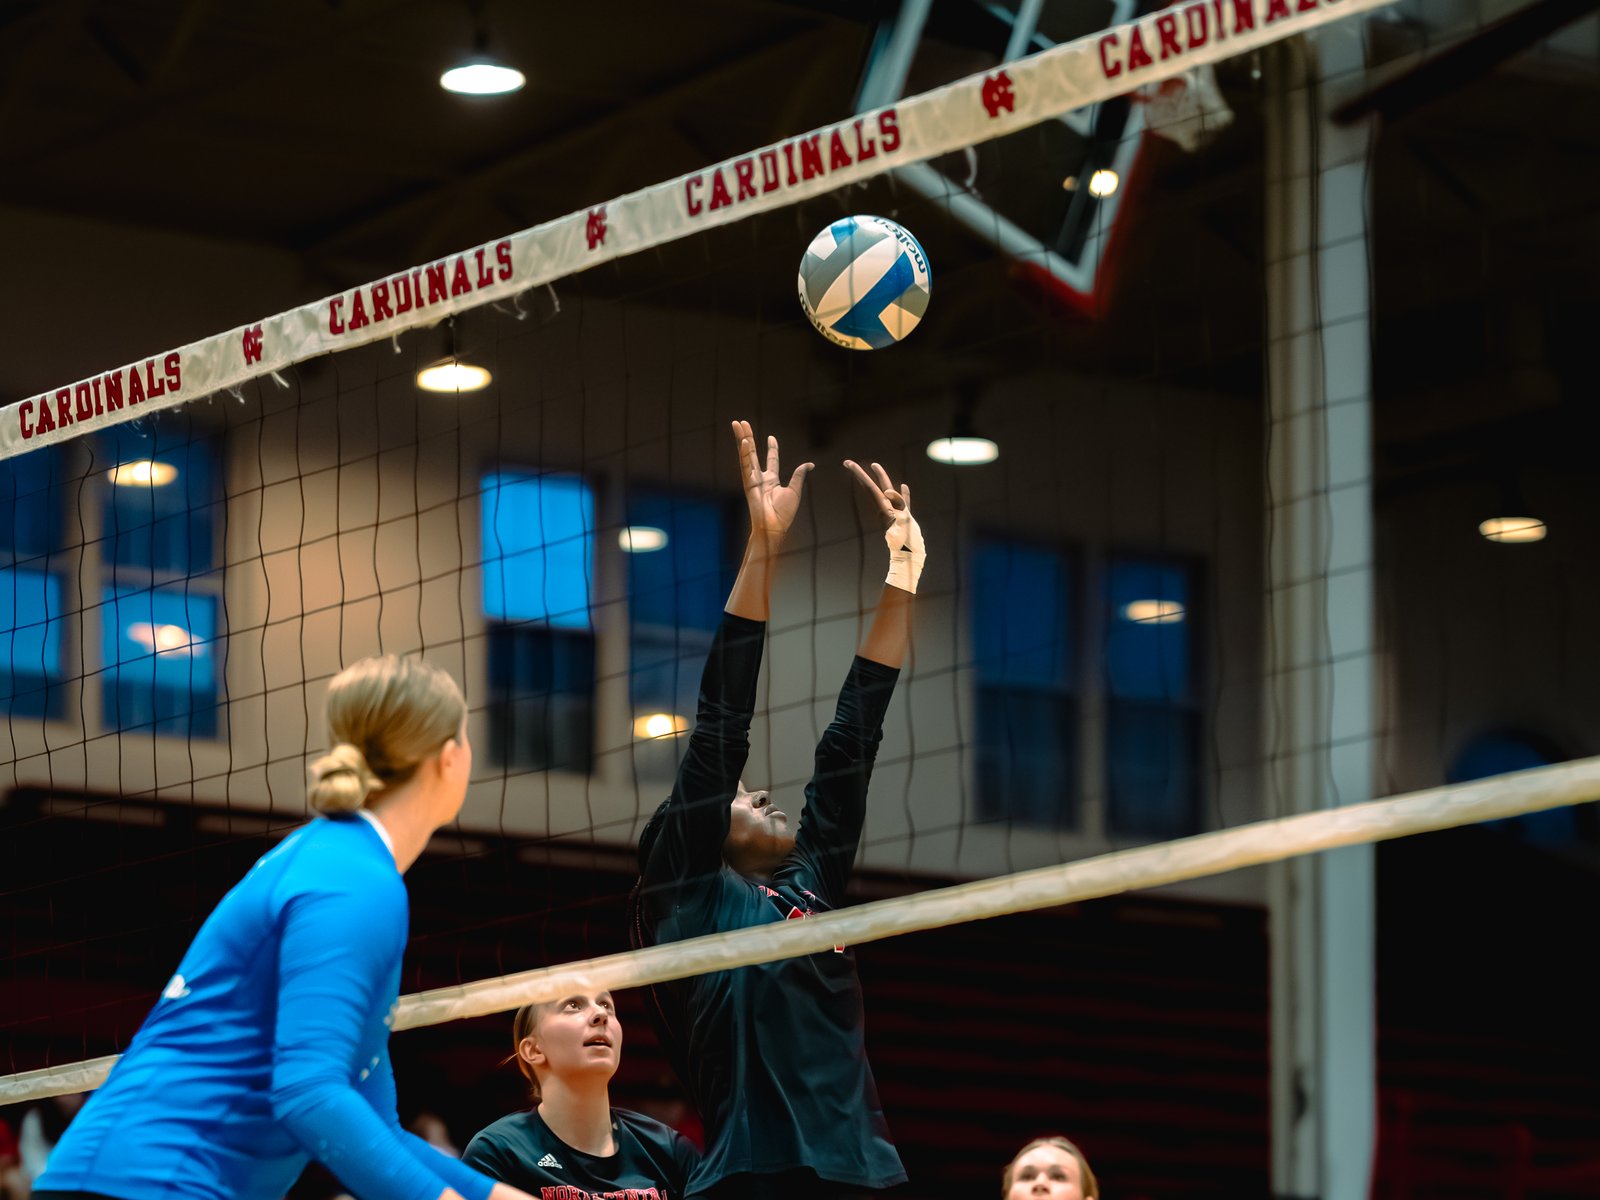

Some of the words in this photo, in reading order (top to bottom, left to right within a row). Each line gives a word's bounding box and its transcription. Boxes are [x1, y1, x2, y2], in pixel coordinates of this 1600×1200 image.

[1099, 0, 1342, 79] CARDINA
[685, 109, 901, 217] CARDINALS
[328, 240, 513, 336] CARDINALS
[873, 217, 927, 274] molten
[18, 352, 182, 440] CARDINALS
